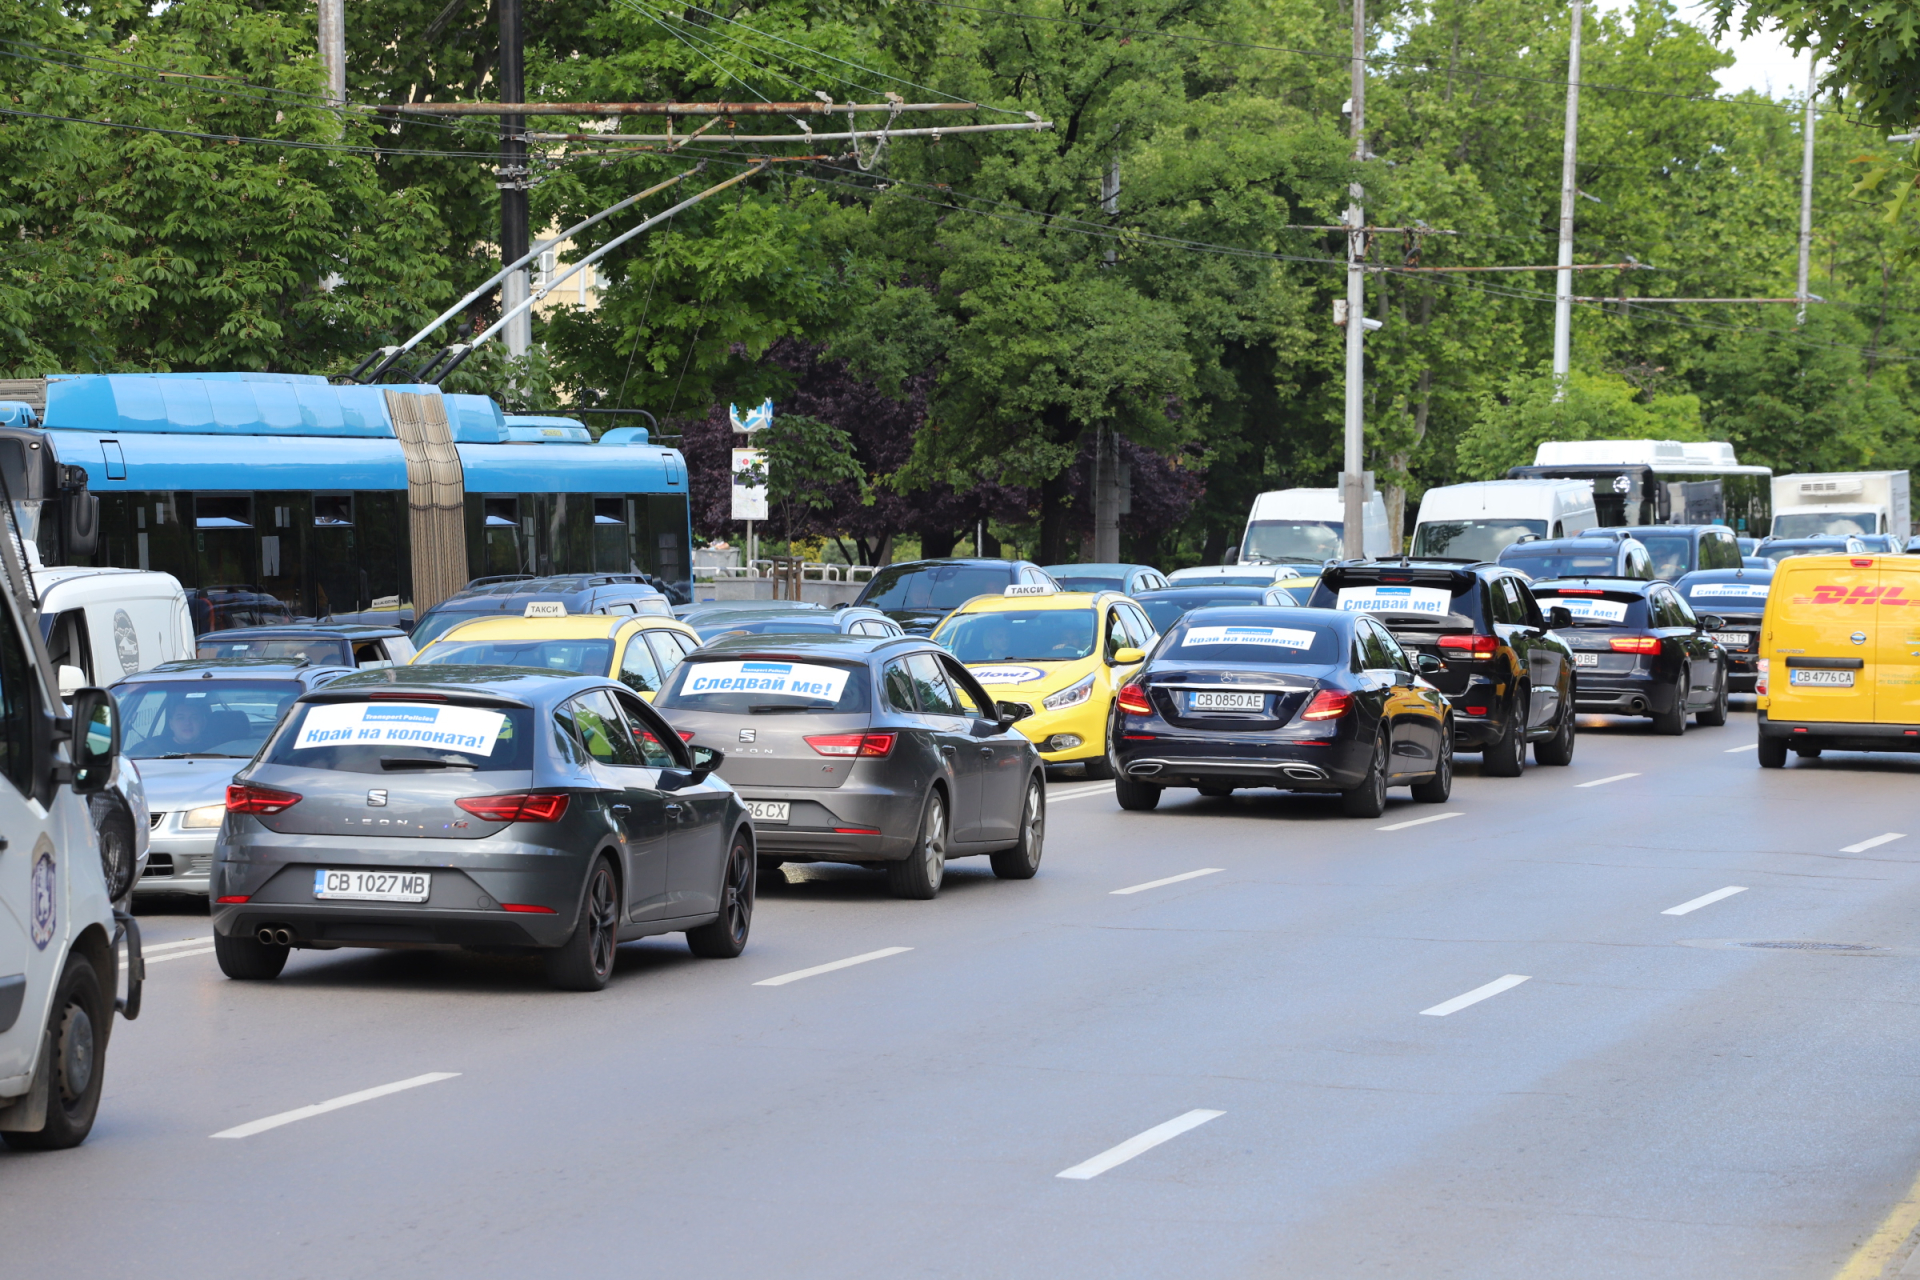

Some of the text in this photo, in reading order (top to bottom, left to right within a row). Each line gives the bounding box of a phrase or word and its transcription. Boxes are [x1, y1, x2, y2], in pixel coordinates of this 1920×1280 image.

[1011, 586, 1044, 594] ТАКСИ
[1811, 586, 1910, 606] DHL
[531, 605, 558, 613] ТАКСИ
[1343, 598, 1441, 612] Следвай ме!
[1593, 609, 1618, 619] ме!
[1189, 636, 1220, 644] Край
[1241, 636, 1305, 647] колоната!
[1797, 671, 1852, 683] CB 4776 CA
[692, 676, 832, 696] Следвай ме!
[1197, 694, 1213, 706] CB
[1215, 694, 1244, 707] 0850
[1246, 695, 1261, 707] AE
[402, 714, 435, 722] Policies
[305, 726, 485, 749] Край на колоната!
[765, 803, 786, 818] CX
[345, 817, 408, 826] LEON
[327, 873, 425, 894] CB 1027 MB
